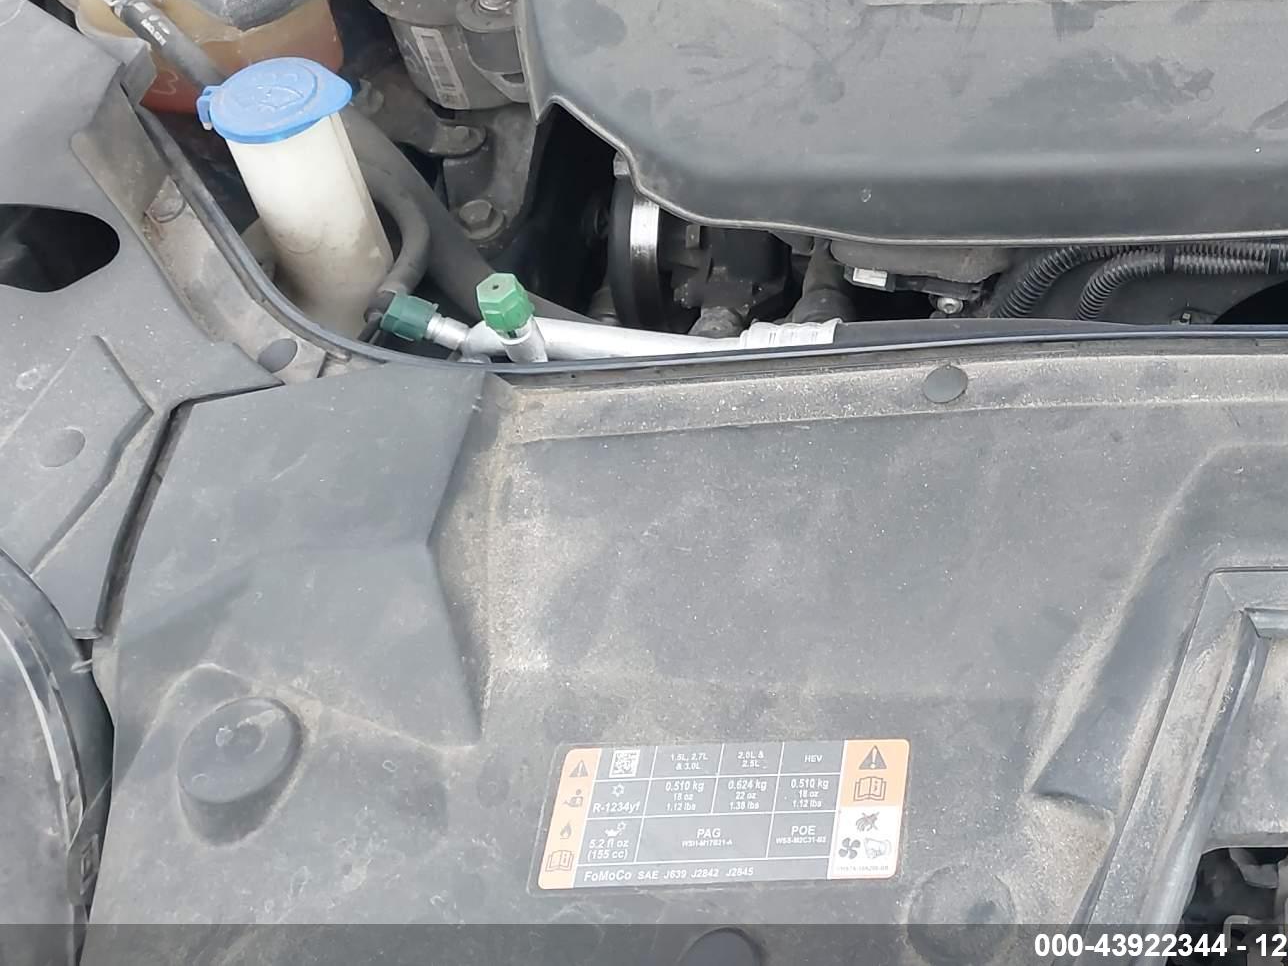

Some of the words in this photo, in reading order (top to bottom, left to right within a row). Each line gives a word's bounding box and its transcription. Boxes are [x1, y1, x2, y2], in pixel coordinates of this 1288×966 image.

[804, 754, 823, 763] HEV
[665, 781, 690, 792] 0.510
[692, 780, 704, 792] kg
[728, 780, 753, 790] 0.624
[755, 780, 767, 792] kg
[790, 778, 816, 789] 0.510
[818, 778, 830, 790] kg
[673, 792, 682, 801] 18
[736, 792, 745, 800] 22
[746, 792, 756, 800] oz
[798, 790, 808, 798] 18
[592, 802, 640, 814] R-1234yf
[667, 803, 683, 811] 1.12
[684, 802, 696, 810] lbs
[748, 801, 760, 809] lbs
[792, 800, 808, 808] 1.12
[810, 800, 822, 808] lbs
[696, 828, 721, 839] PAG
[791, 825, 816, 836] POE
[588, 838, 604, 848] 5.2
[606, 838, 614, 848] fl
[616, 840, 630, 848] oz
[587, 849, 610, 862] (155
[612, 848, 628, 860] cc)
[584, 869, 632, 882] FoMoCo
[637, 870, 660, 880] SAE
[663, 869, 687, 880] J639
[690, 868, 720, 878] J2842
[726, 867, 754, 878] J2845
